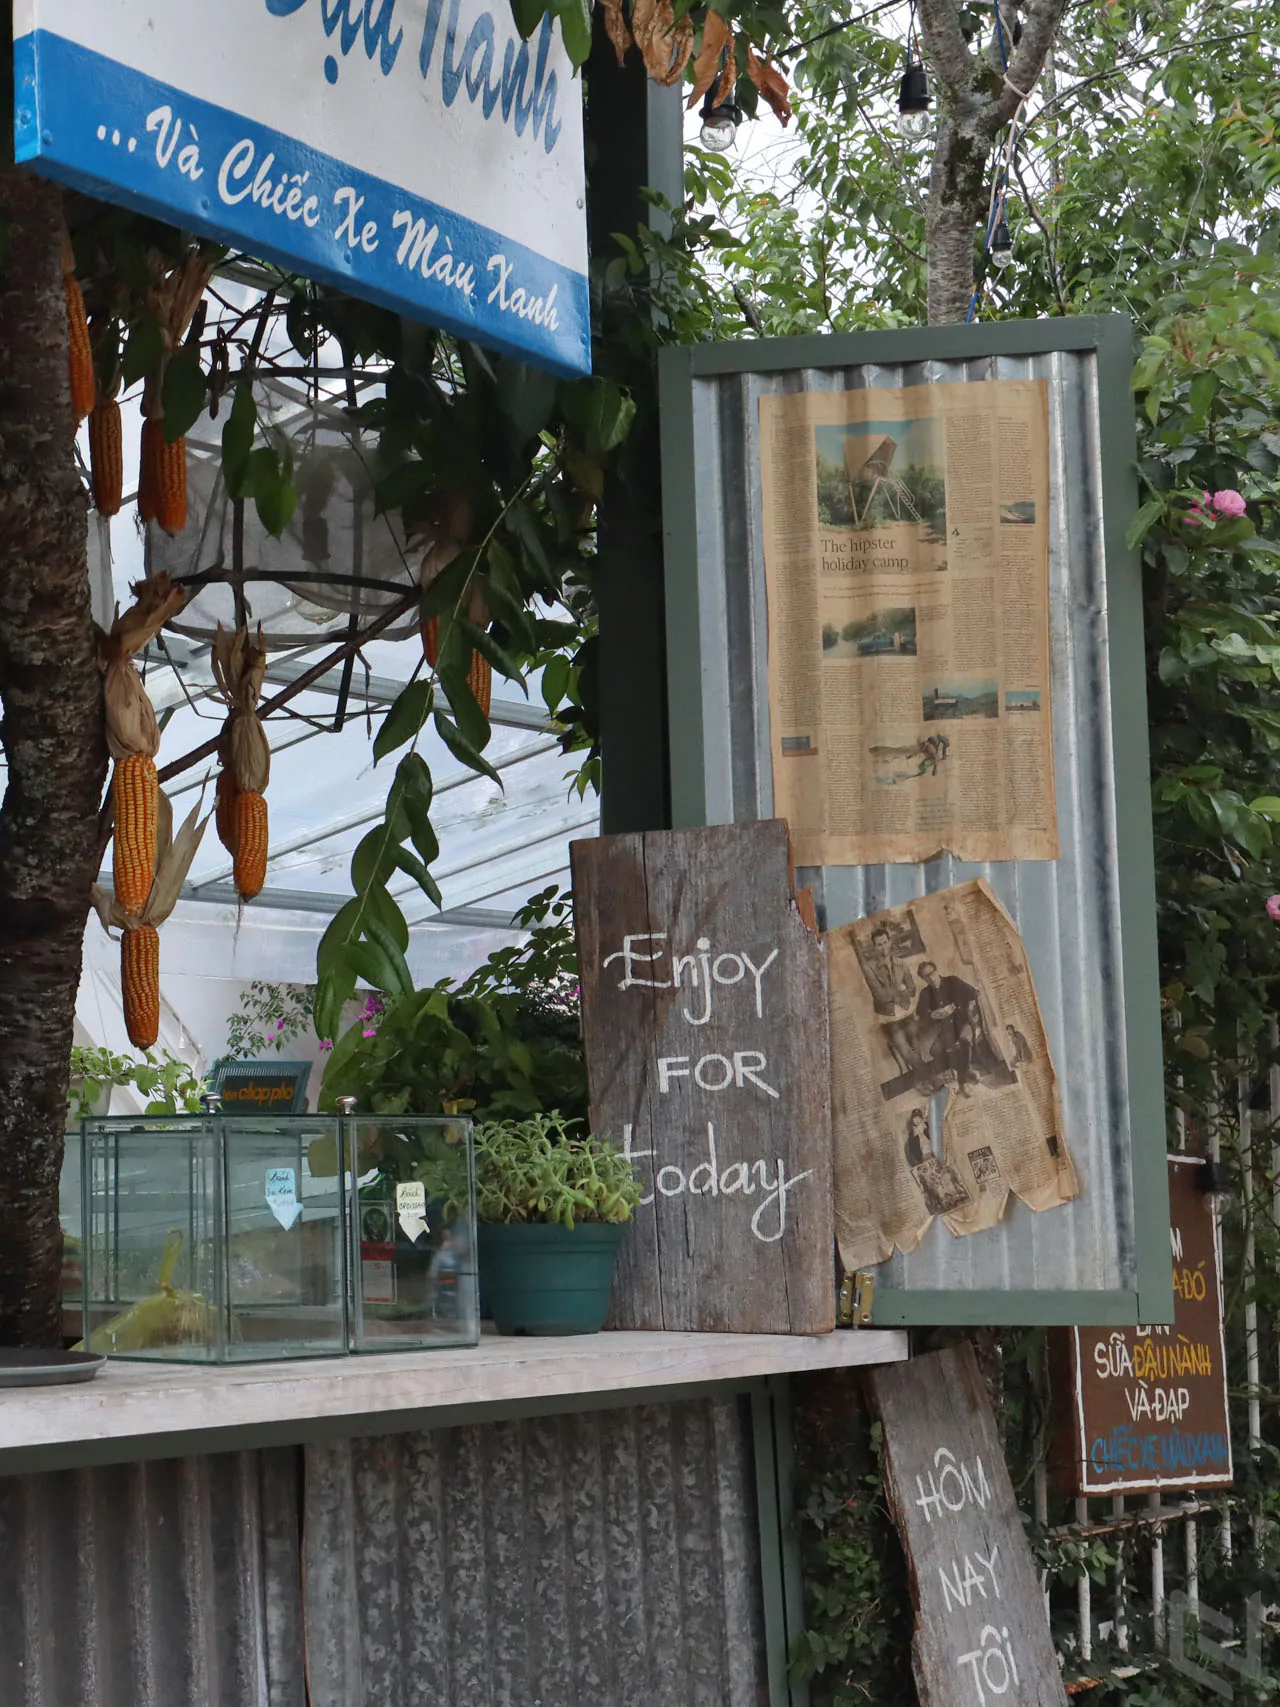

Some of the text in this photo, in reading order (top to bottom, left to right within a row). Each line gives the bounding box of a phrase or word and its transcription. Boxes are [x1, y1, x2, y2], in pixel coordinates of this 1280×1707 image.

[218, 138, 320, 228] Chiếc
[333, 186, 379, 253] Xe
[392, 209, 475, 296] Màu
[487, 254, 560, 332] Xanh
[821, 537, 896, 554] The hipster
[821, 556, 909, 573] holiday camp
[603, 932, 779, 1026] Enjoy
[657, 1050, 780, 1098] FOR
[614, 1121, 815, 1243] today
[1094, 1332, 1213, 1382] SỮA ĐẬU NÀNH
[1124, 1379, 1190, 1424] VÀ ĐẠP
[915, 1447, 991, 1523] HÔM
[939, 1543, 1000, 1613] NAY
